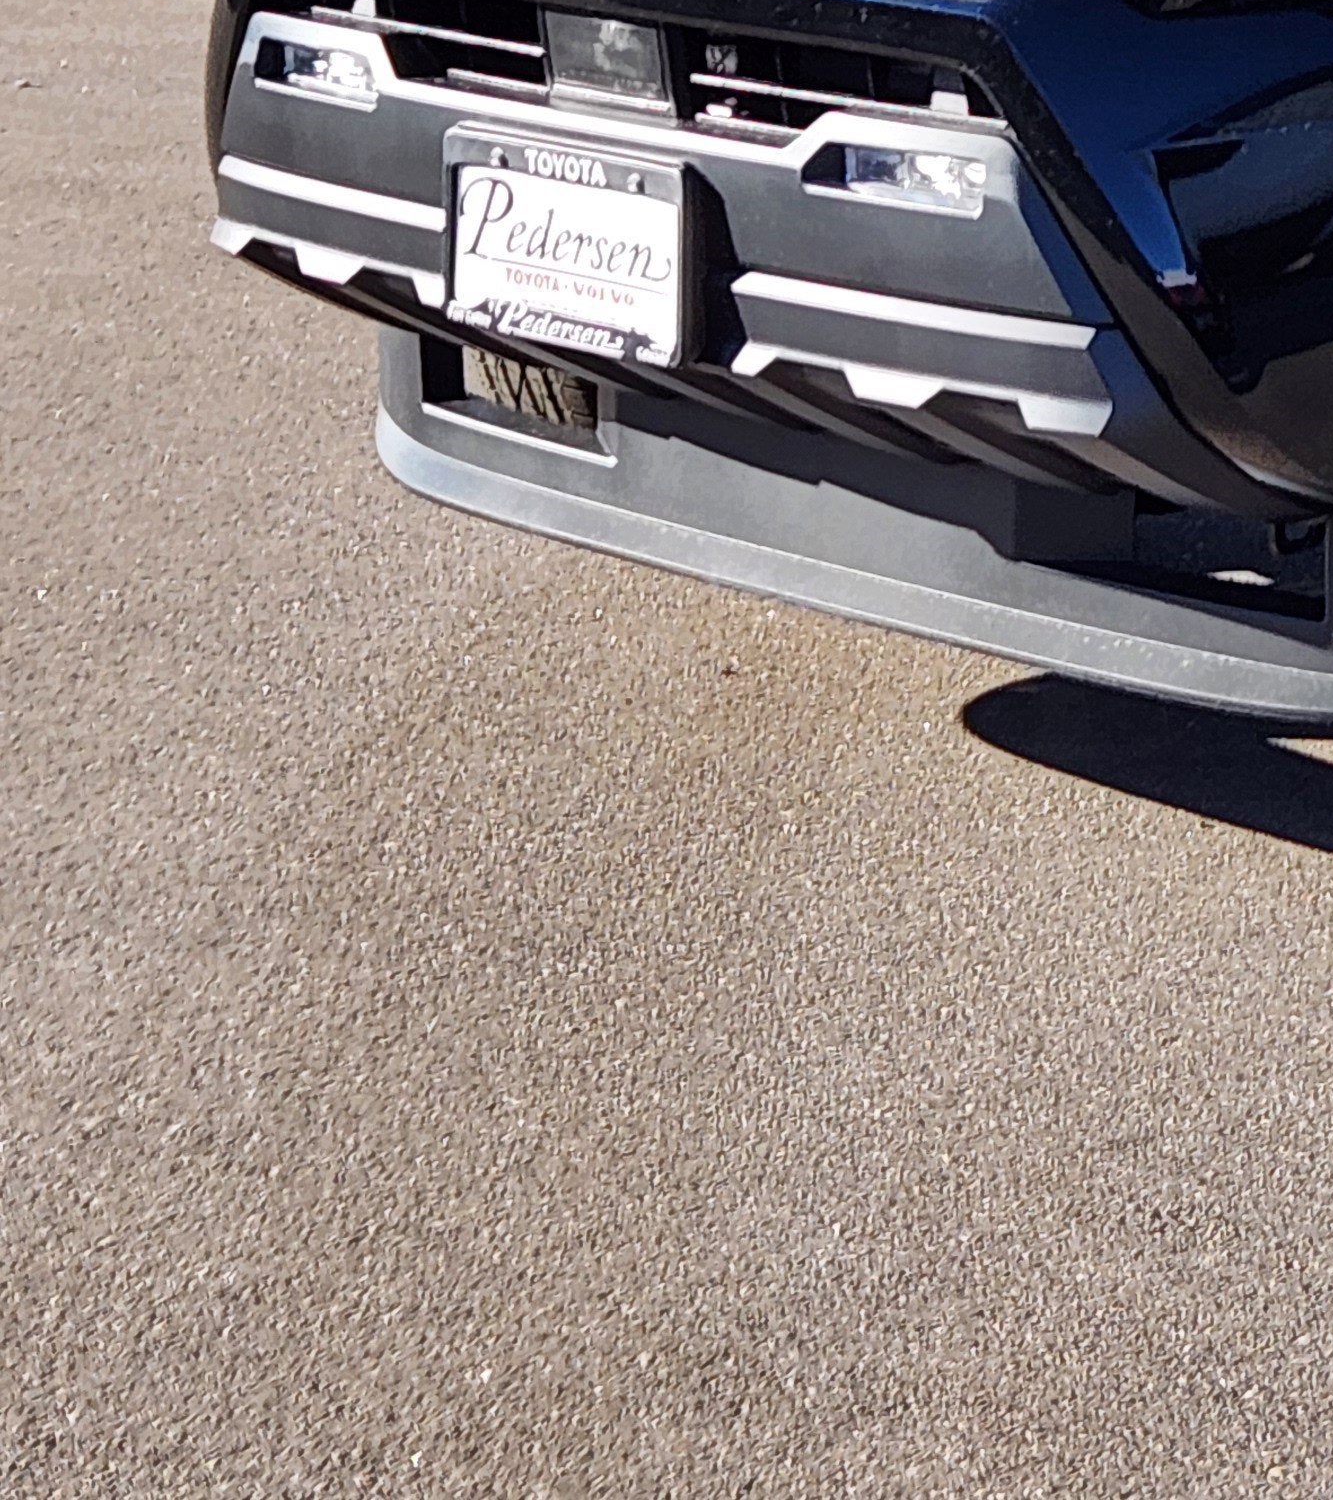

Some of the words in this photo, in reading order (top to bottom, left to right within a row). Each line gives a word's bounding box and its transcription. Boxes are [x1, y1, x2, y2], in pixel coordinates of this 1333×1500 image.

[524, 147, 607, 187] TOYOTA
[459, 176, 672, 282] Pedersen
[505, 267, 560, 292] TOYOTA
[488, 299, 625, 352] Pedersen
